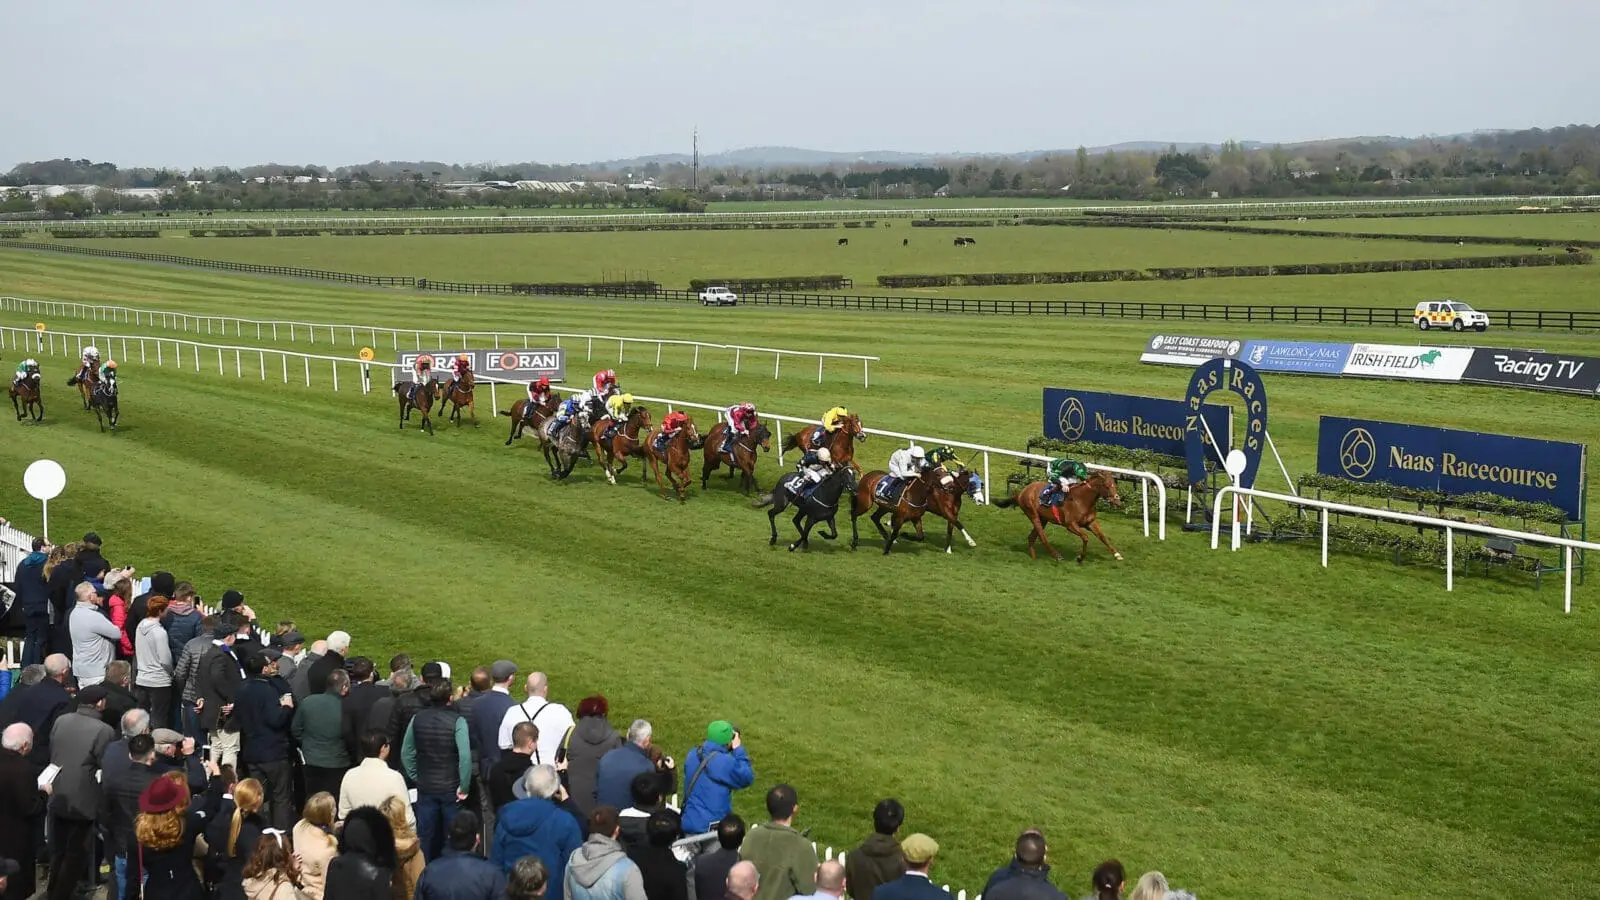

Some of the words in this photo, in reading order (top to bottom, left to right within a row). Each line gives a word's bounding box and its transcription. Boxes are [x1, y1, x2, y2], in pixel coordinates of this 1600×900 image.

[1164, 336, 1180, 345] EAST
[1179, 337, 1200, 347] COAST
[1200, 338, 1229, 349] SEAFOOD
[490, 353, 555, 370] FORAN
[1317, 348, 1341, 358] NAAS
[1351, 353, 1384, 367] IRISH
[1383, 355, 1420, 369] FIELD
[1494, 355, 1553, 381] Racing
[1556, 360, 1585, 379] TV
[1095, 411, 1128, 433] Naas
[1388, 445, 1434, 472] Naas
[1441, 452, 1558, 490] Racecourse
